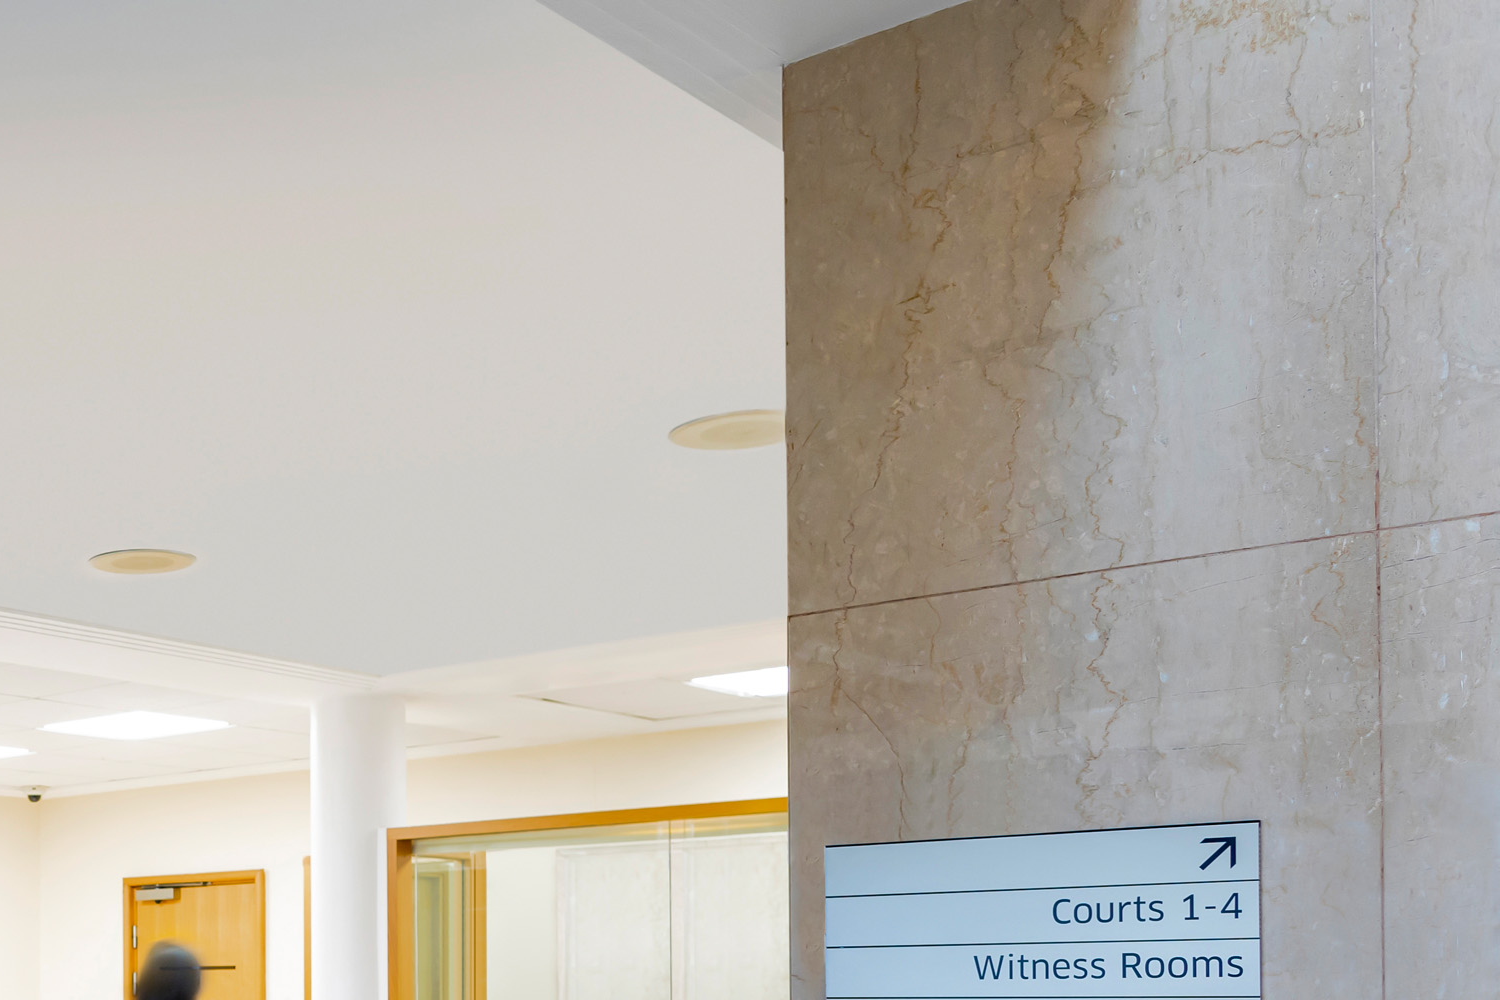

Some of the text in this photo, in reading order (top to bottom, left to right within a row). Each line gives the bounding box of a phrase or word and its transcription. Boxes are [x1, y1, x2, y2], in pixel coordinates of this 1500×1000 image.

[1052, 892, 1243, 925] Courts 1-4
[973, 952, 1244, 980] Witness Rooms
